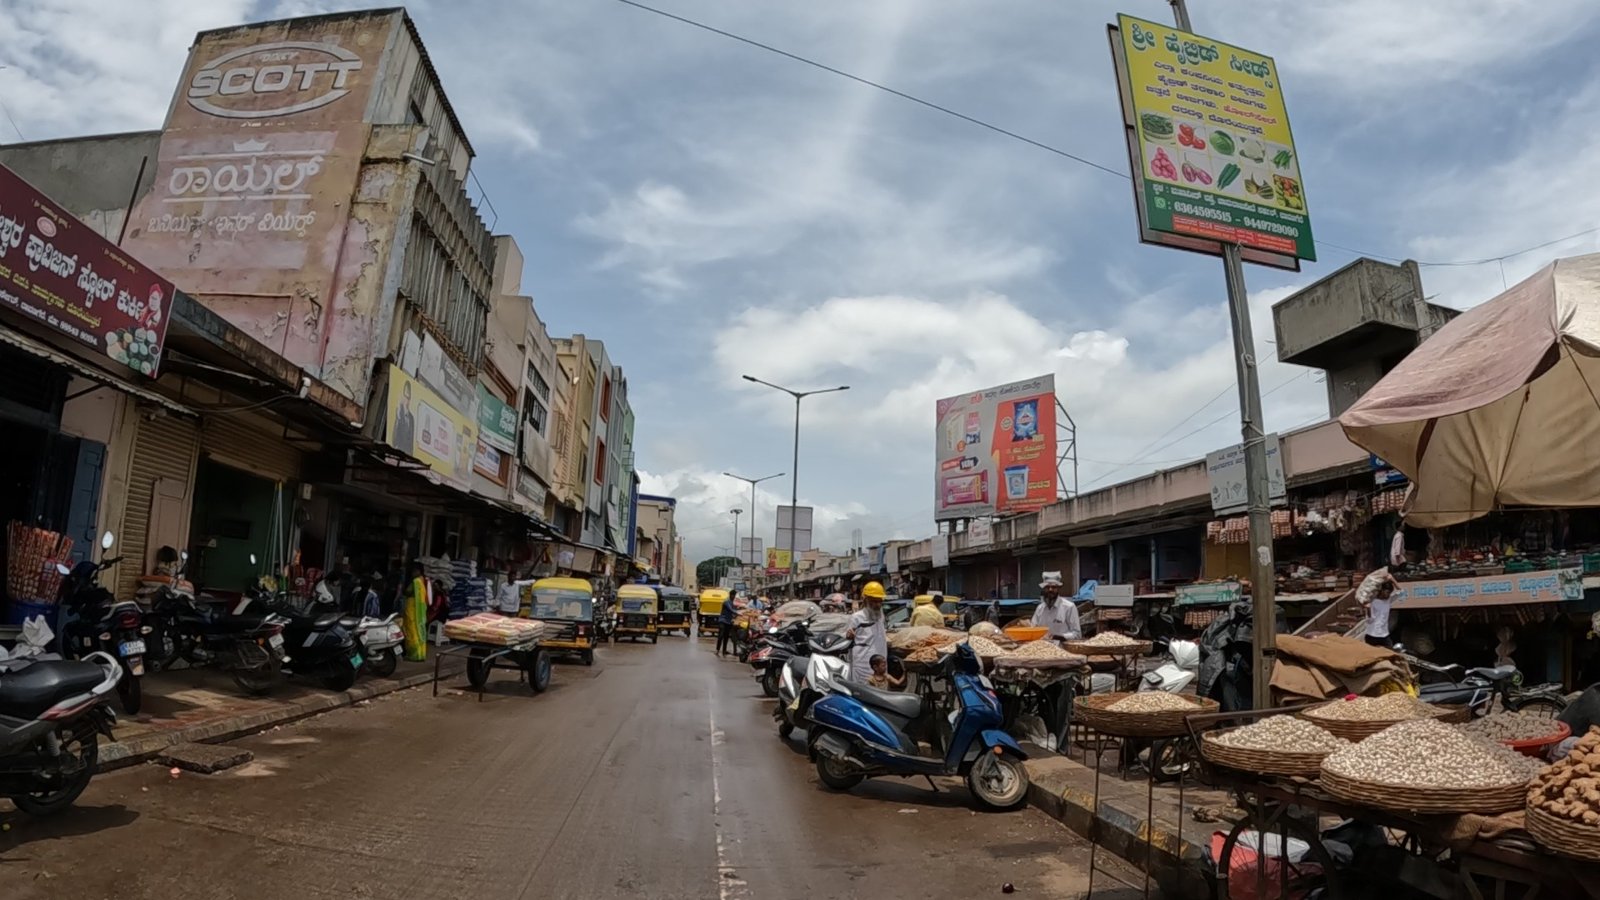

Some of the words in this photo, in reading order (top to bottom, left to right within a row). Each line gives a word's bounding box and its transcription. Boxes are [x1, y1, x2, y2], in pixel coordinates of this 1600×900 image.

[1131, 23, 1156, 50] ಶ್ರೀ
[1164, 33, 1219, 65] ಹೈಬ್ರಿಡ್
[1230, 53, 1274, 89] ಸೀಡ್ಸ್
[188, 60, 363, 98] SCOTT
[169, 155, 325, 196] ರಾಯಲ್
